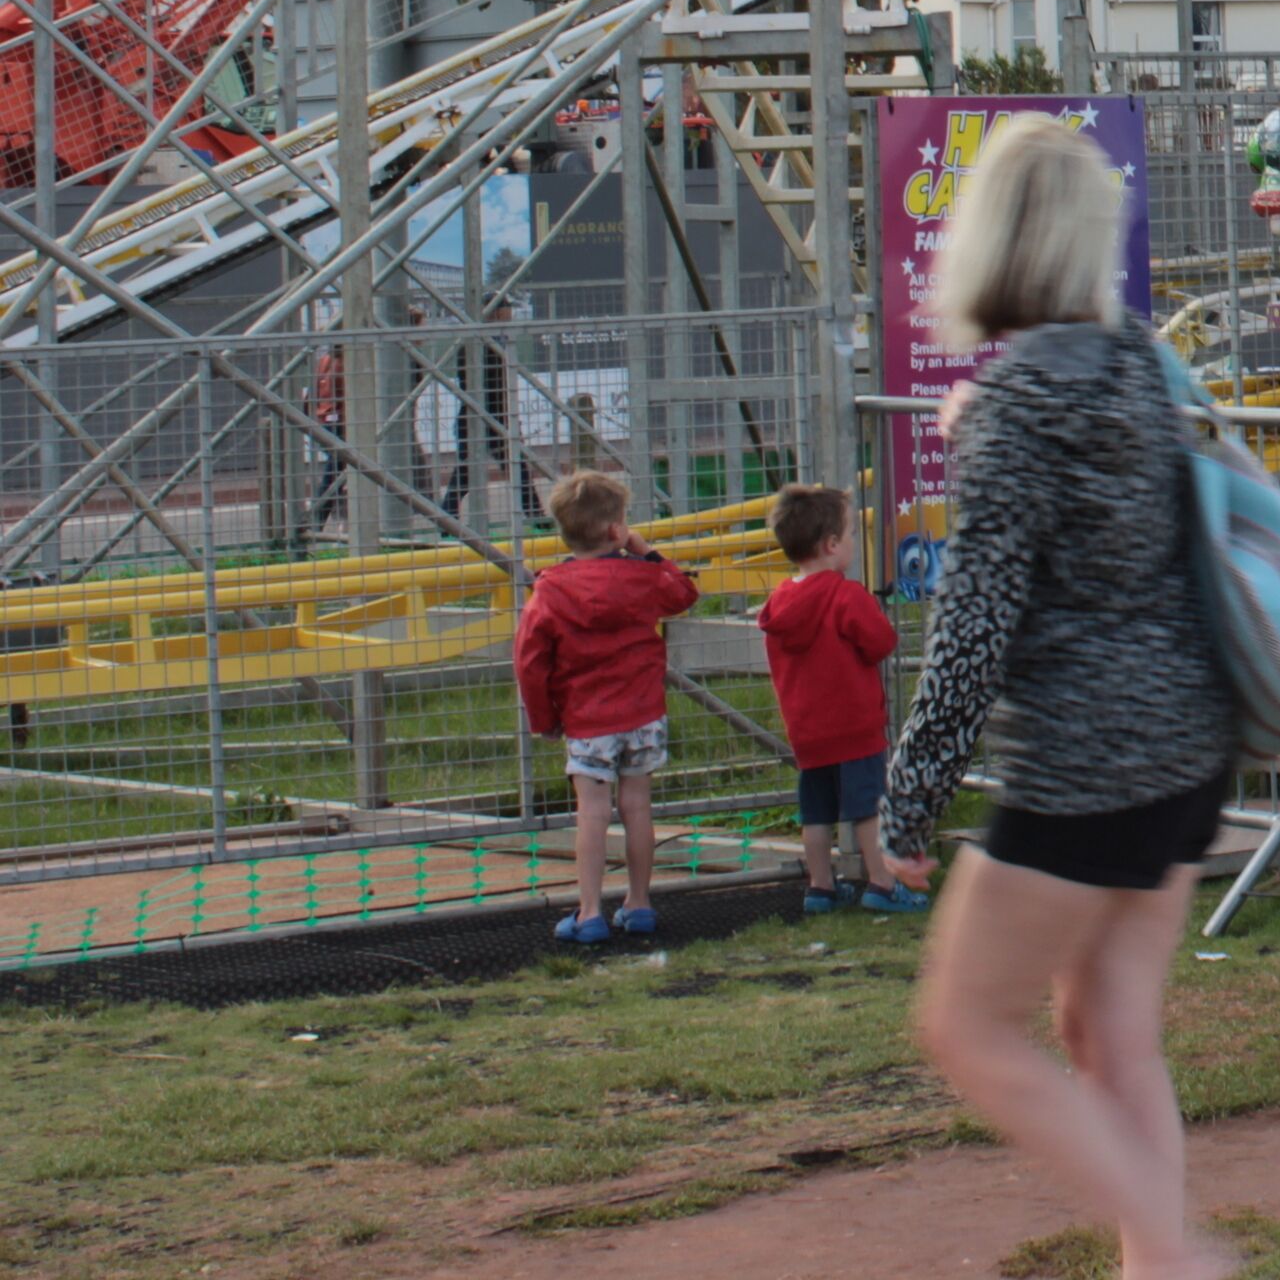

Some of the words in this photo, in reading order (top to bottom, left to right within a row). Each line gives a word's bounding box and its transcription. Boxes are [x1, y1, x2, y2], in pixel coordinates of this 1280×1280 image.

[909, 274, 925, 286] All
[910, 316, 940, 330] Keep
[910, 341, 943, 355] Small
[910, 357, 925, 371] by
[928, 358, 942, 368] an
[946, 355, 978, 367] adult.
[911, 383, 950, 396] Please
[931, 450, 959, 464] fod
